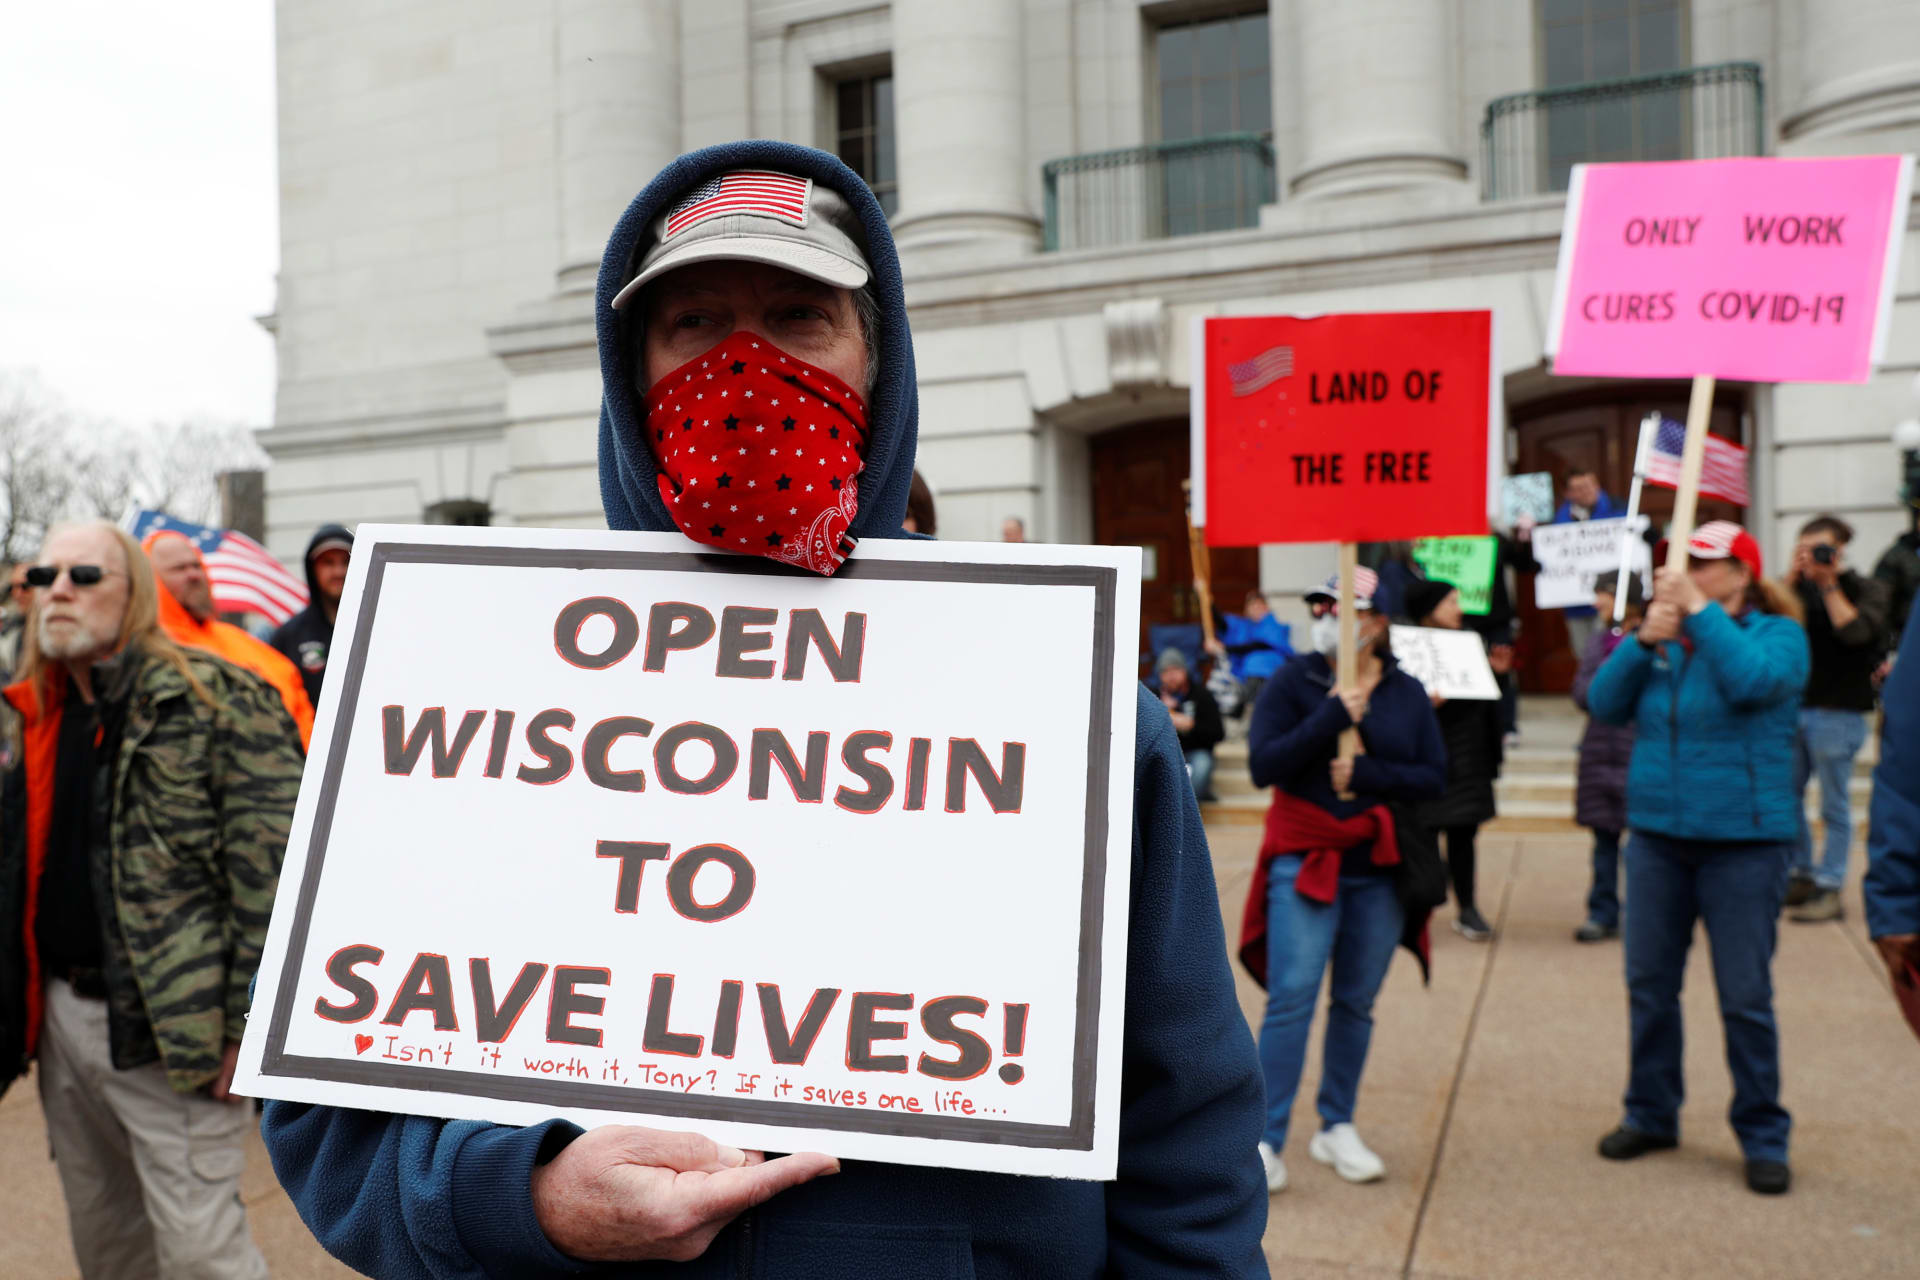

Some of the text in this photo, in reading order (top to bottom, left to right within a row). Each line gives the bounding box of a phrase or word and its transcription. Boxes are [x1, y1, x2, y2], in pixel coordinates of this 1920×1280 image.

[1625, 215, 1846, 246] ONLY WORK
[1583, 291, 1845, 323] CURES COVID-19
[1309, 369, 1443, 404] LAND OF
[1290, 451, 1431, 485] THE FREE
[553, 595, 868, 684] OPEN
[381, 704, 1027, 815] WISCONSIN
[595, 839, 757, 924] TO
[313, 943, 1030, 1086] SAVE LIVES!
[381, 1035, 1009, 1117] Isn't it worth it, Tony? If it saves one life...
